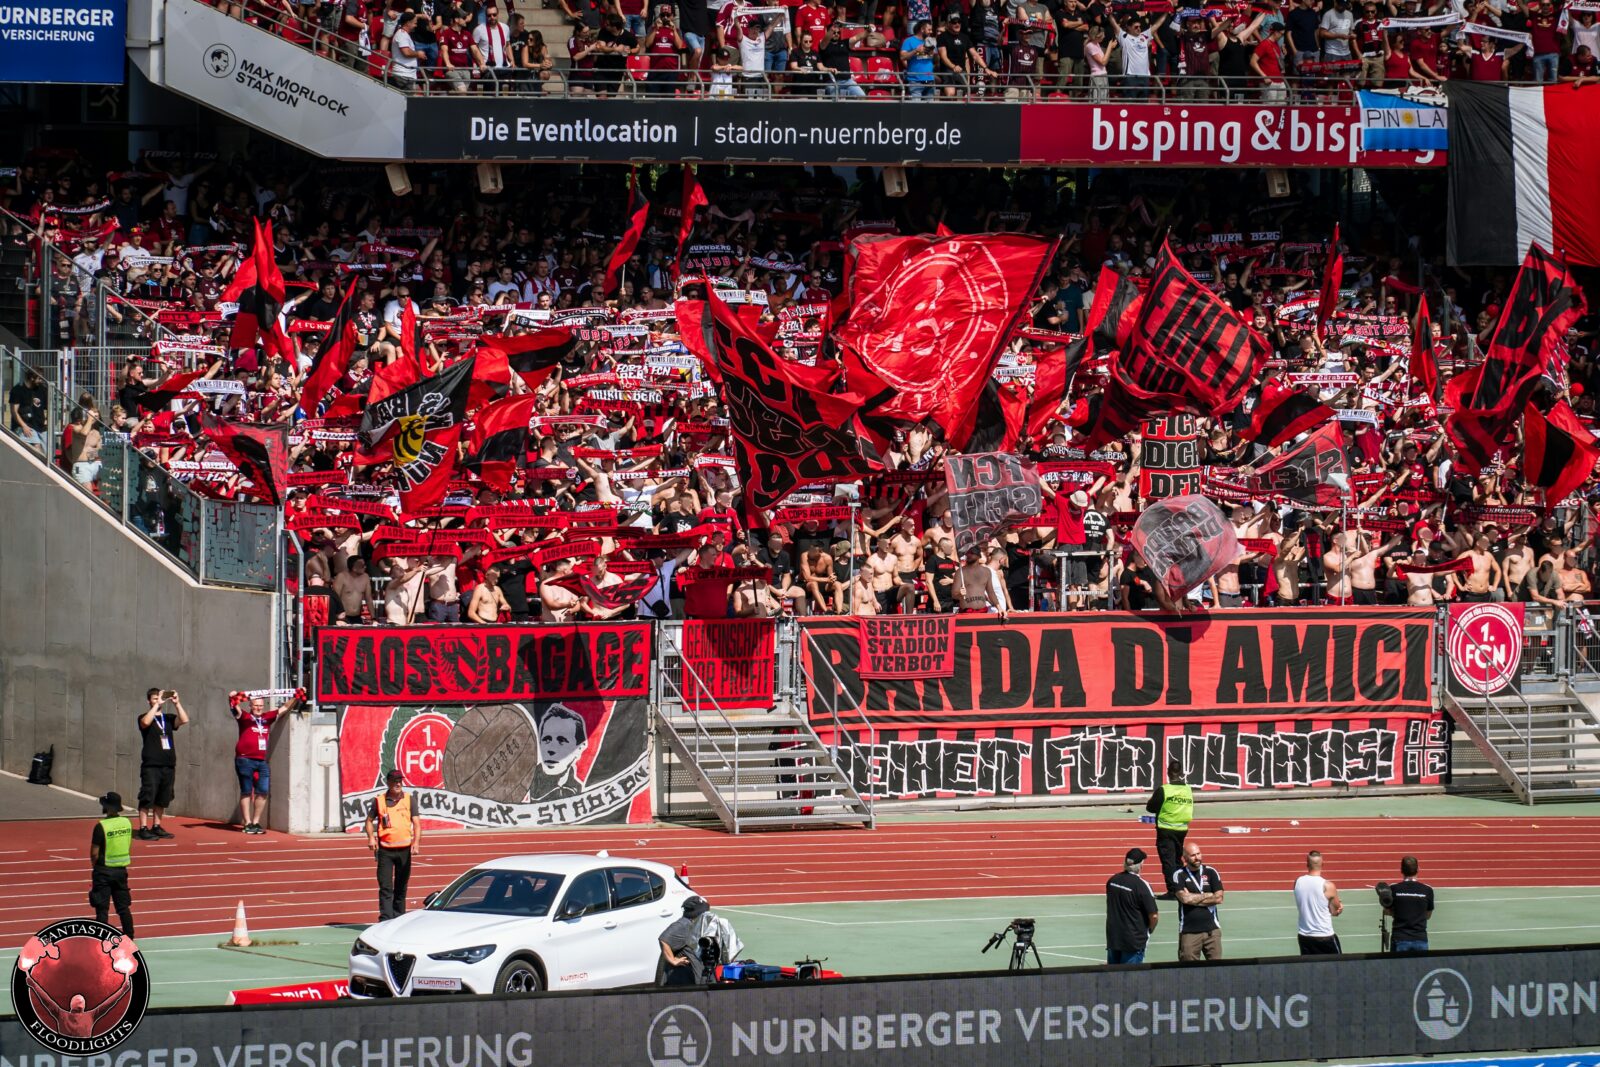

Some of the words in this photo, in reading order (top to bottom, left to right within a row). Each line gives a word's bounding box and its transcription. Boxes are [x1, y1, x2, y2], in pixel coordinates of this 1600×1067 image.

[2, 29, 95, 42] VERSICHERUNG
[236, 71, 299, 108] STADION
[240, 59, 273, 82] MAX
[277, 74, 349, 117] MORLOCK
[470, 117, 509, 142] Die
[516, 117, 678, 143] Eventlocation
[714, 120, 962, 152] stadion-nuernberg.de
[1092, 107, 1242, 163] bisping
[1251, 109, 1282, 152] &
[651, 366, 672, 376] FCN
[1150, 472, 1200, 498] DFB
[1256, 448, 1343, 492] 1312
[788, 508, 808, 520] COPS
[809, 507, 824, 518] ARE
[687, 620, 774, 661] GEMEINSCHAFT
[867, 618, 950, 636] SEKTION
[1480, 621, 1495, 643] 1.
[322, 634, 432, 696] KAOS
[486, 630, 645, 695] BAGAGE
[867, 636, 949, 655] STADION
[1465, 643, 1507, 670] FCN
[687, 660, 717, 696] VOR
[721, 657, 770, 694] PROFIT
[871, 654, 946, 673] VERBOT
[1111, 627, 1193, 708] DI
[1217, 623, 1431, 706] AMICI
[422, 724, 437, 747] 1.
[1044, 725, 1156, 791] FÜR
[1166, 728, 1397, 791] ULTRAS!
[417, 979, 456, 987] kummich
[1491, 980, 1598, 1019] NÜRN
[731, 1008, 1001, 1058] NÜRNBERGER
[1014, 994, 1310, 1042] VERSICHERUNG
[213, 1031, 533, 1067] VERSICHERUNG
